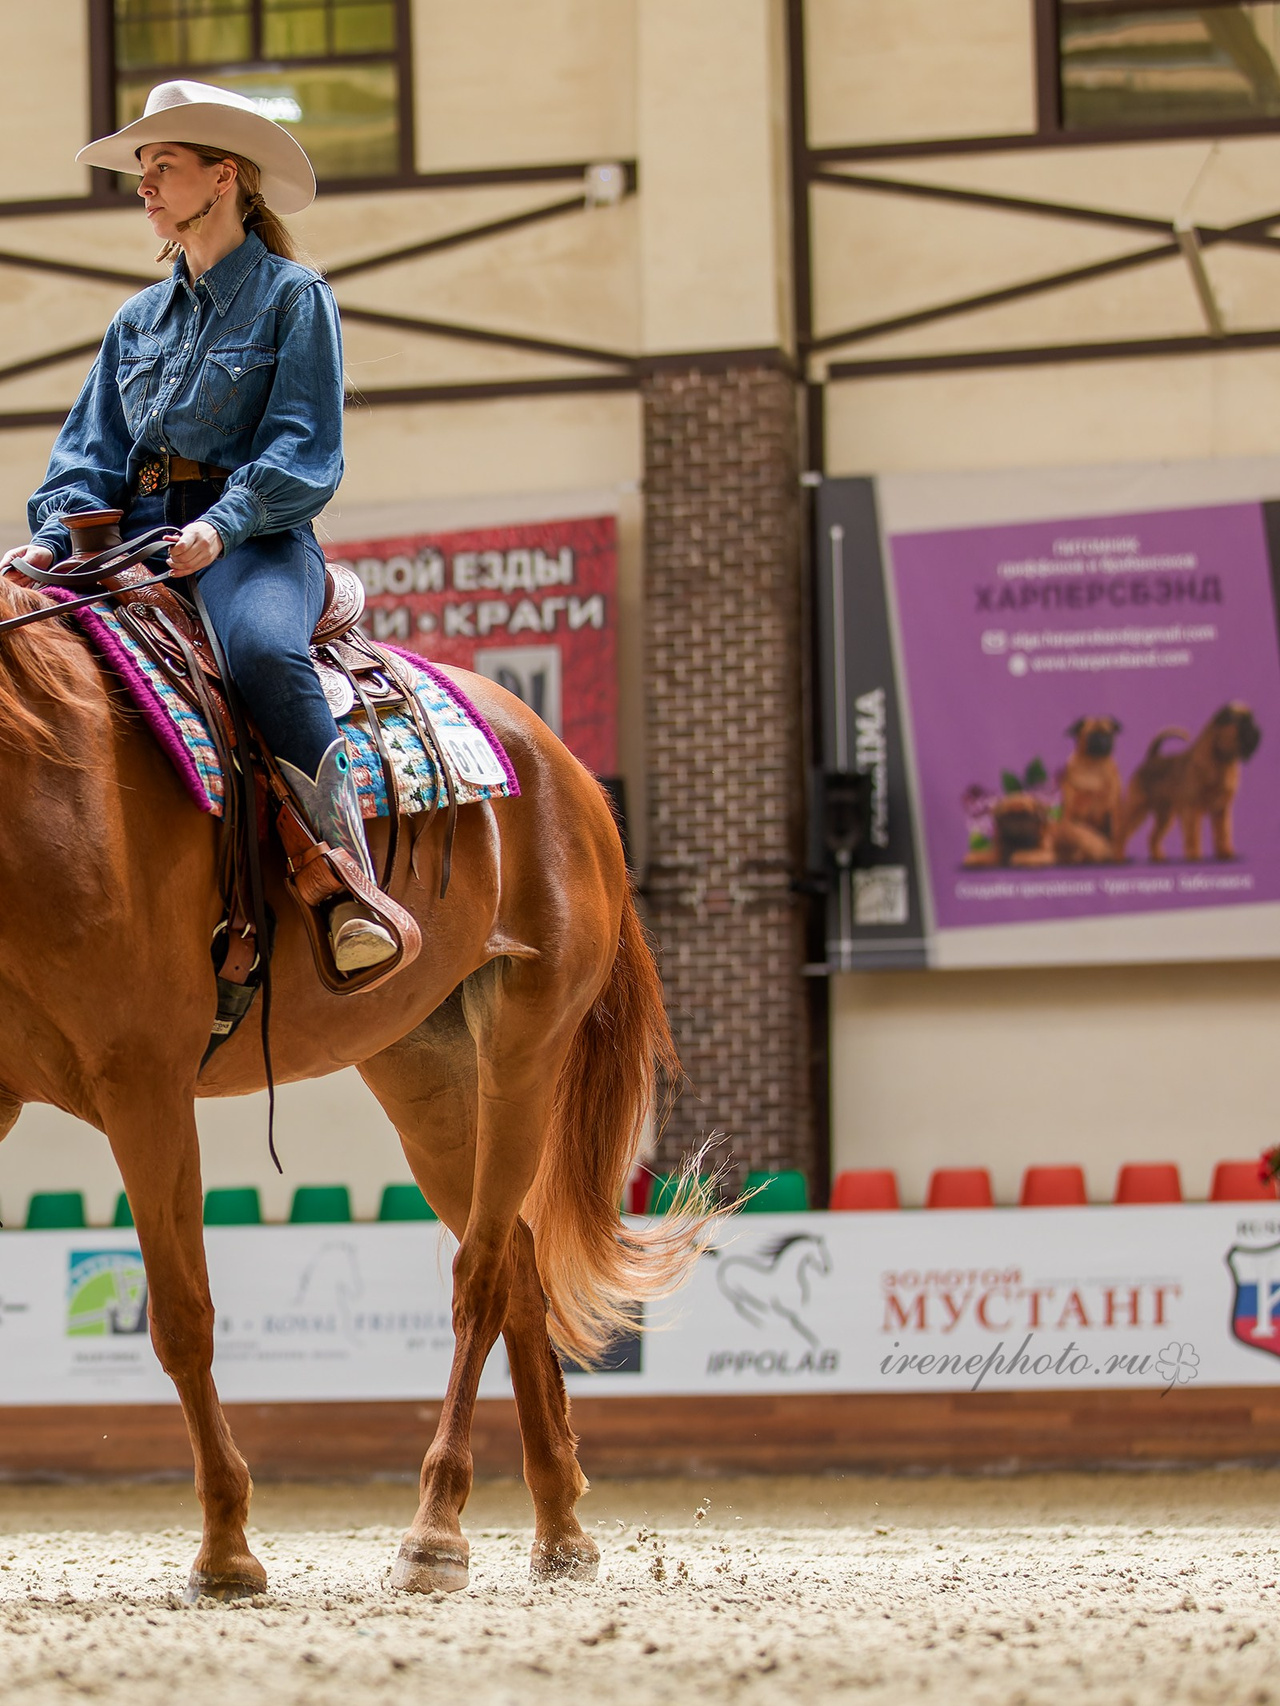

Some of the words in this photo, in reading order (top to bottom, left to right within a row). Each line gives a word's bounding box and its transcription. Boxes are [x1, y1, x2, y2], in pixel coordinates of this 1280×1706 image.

[453, 548, 571, 592] ЕЗДЫ
[977, 578, 1222, 610] ХАРПЕРСБЭНД
[445, 596, 603, 634] КРАГИ
[880, 1267, 1023, 1288] ЗОЛОТОЙ
[881, 1285, 1182, 1332] МУСТАНГ
[707, 1352, 839, 1375] IPPOLAB
